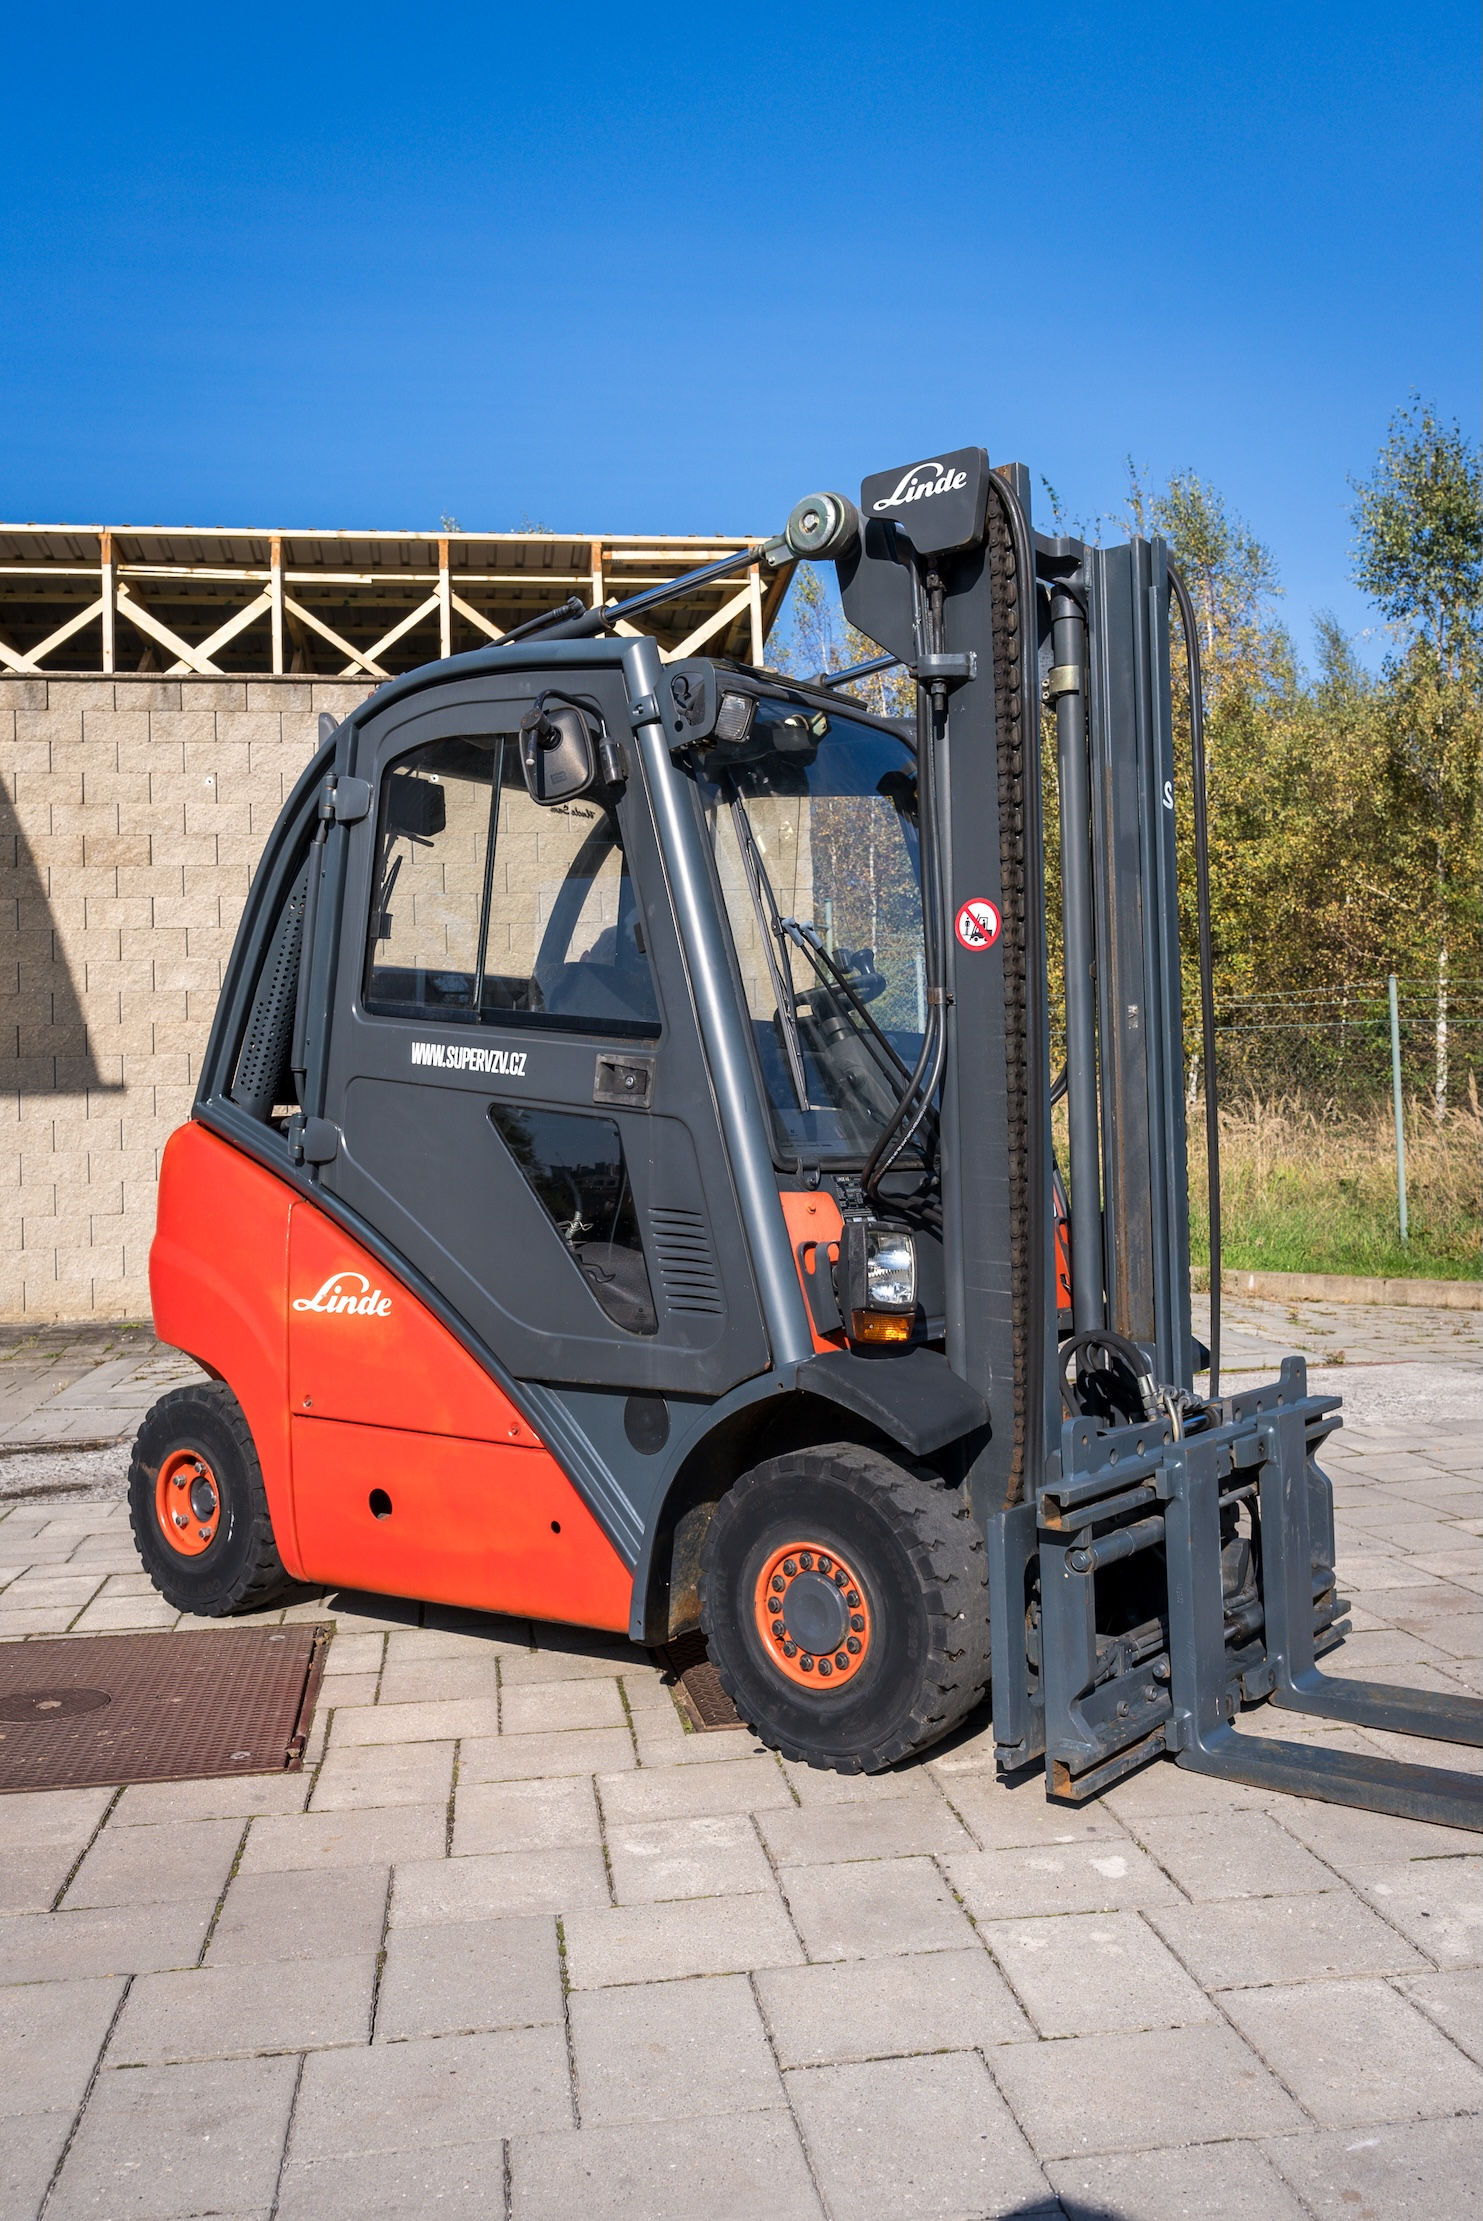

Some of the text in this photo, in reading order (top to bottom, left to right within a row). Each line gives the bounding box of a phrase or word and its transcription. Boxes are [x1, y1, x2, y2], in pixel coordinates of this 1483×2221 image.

[873, 462, 967, 511] Linde
[411, 1041, 528, 1076] WWW.SUPERVZV.CZ
[292, 1271, 392, 1317] Linde
